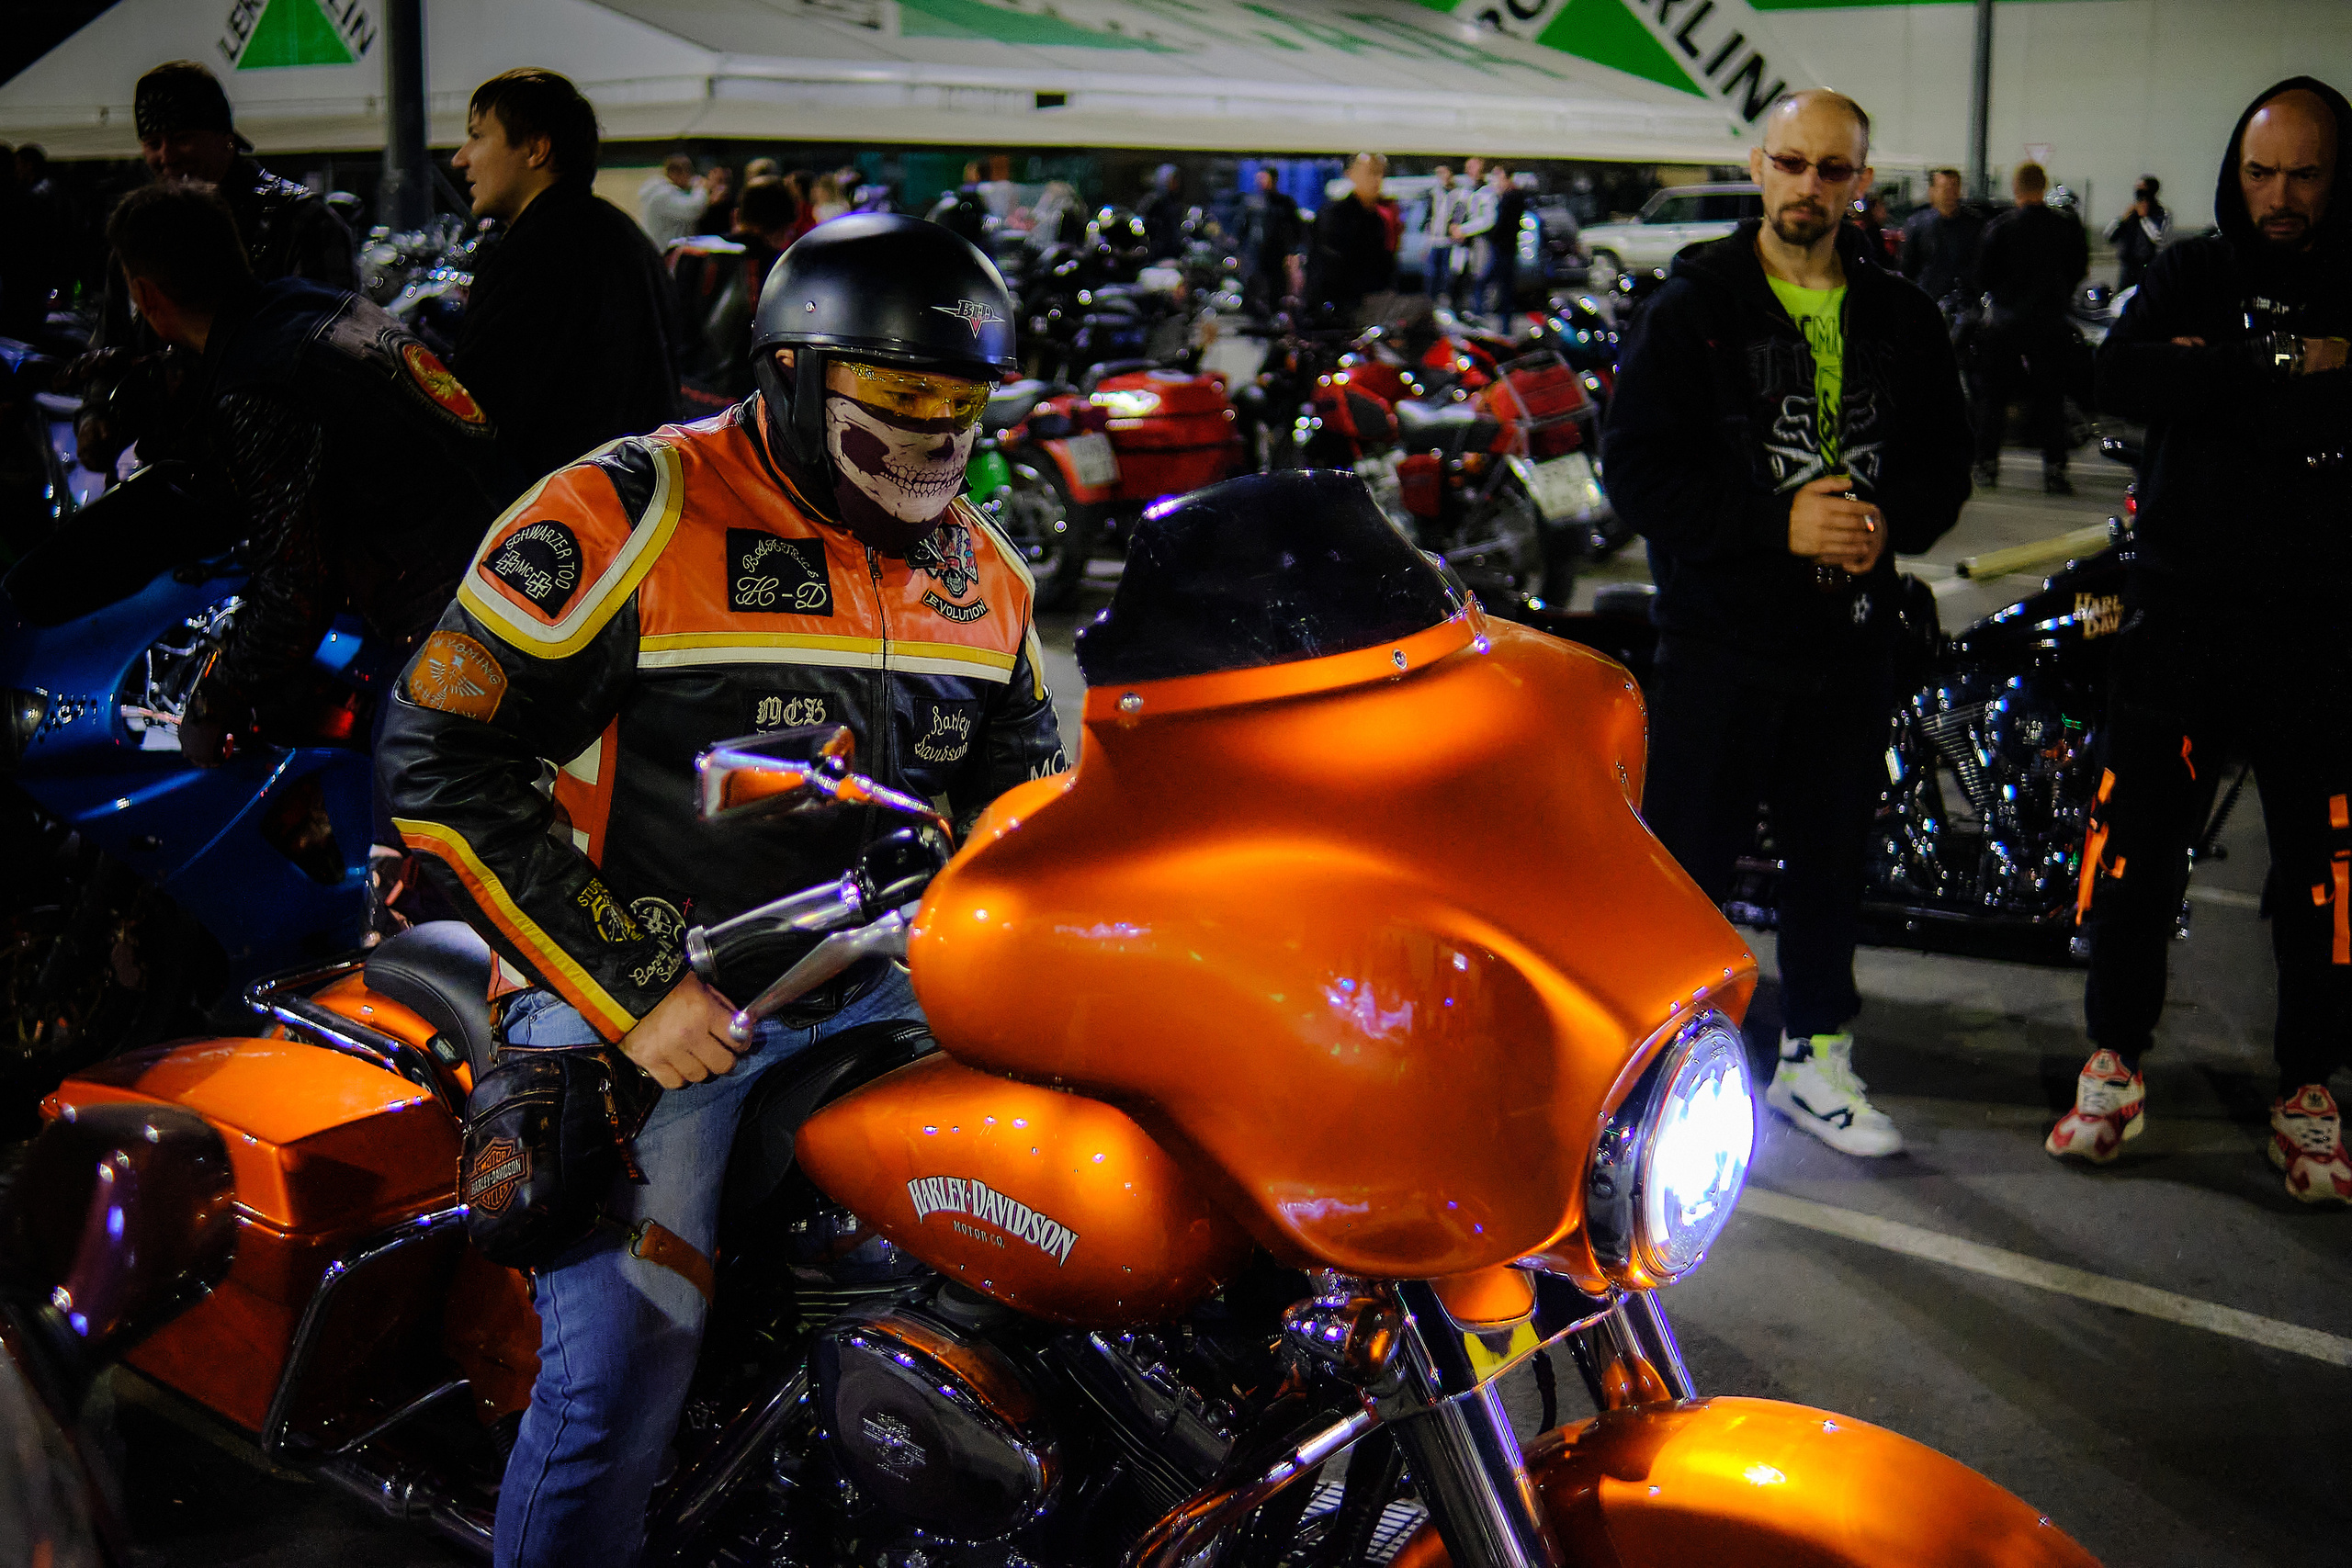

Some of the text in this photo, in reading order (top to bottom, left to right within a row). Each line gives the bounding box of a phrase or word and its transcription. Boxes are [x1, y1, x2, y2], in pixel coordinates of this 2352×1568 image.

[505, 525, 575, 590] SCHWARZER TOD
[515, 558, 533, 578] MC
[925, 593, 987, 621] EVOLUTION
[931, 705, 971, 740] Harley
[914, 734, 968, 762] Davidson
[953, 1220, 989, 1242] MOTOR
